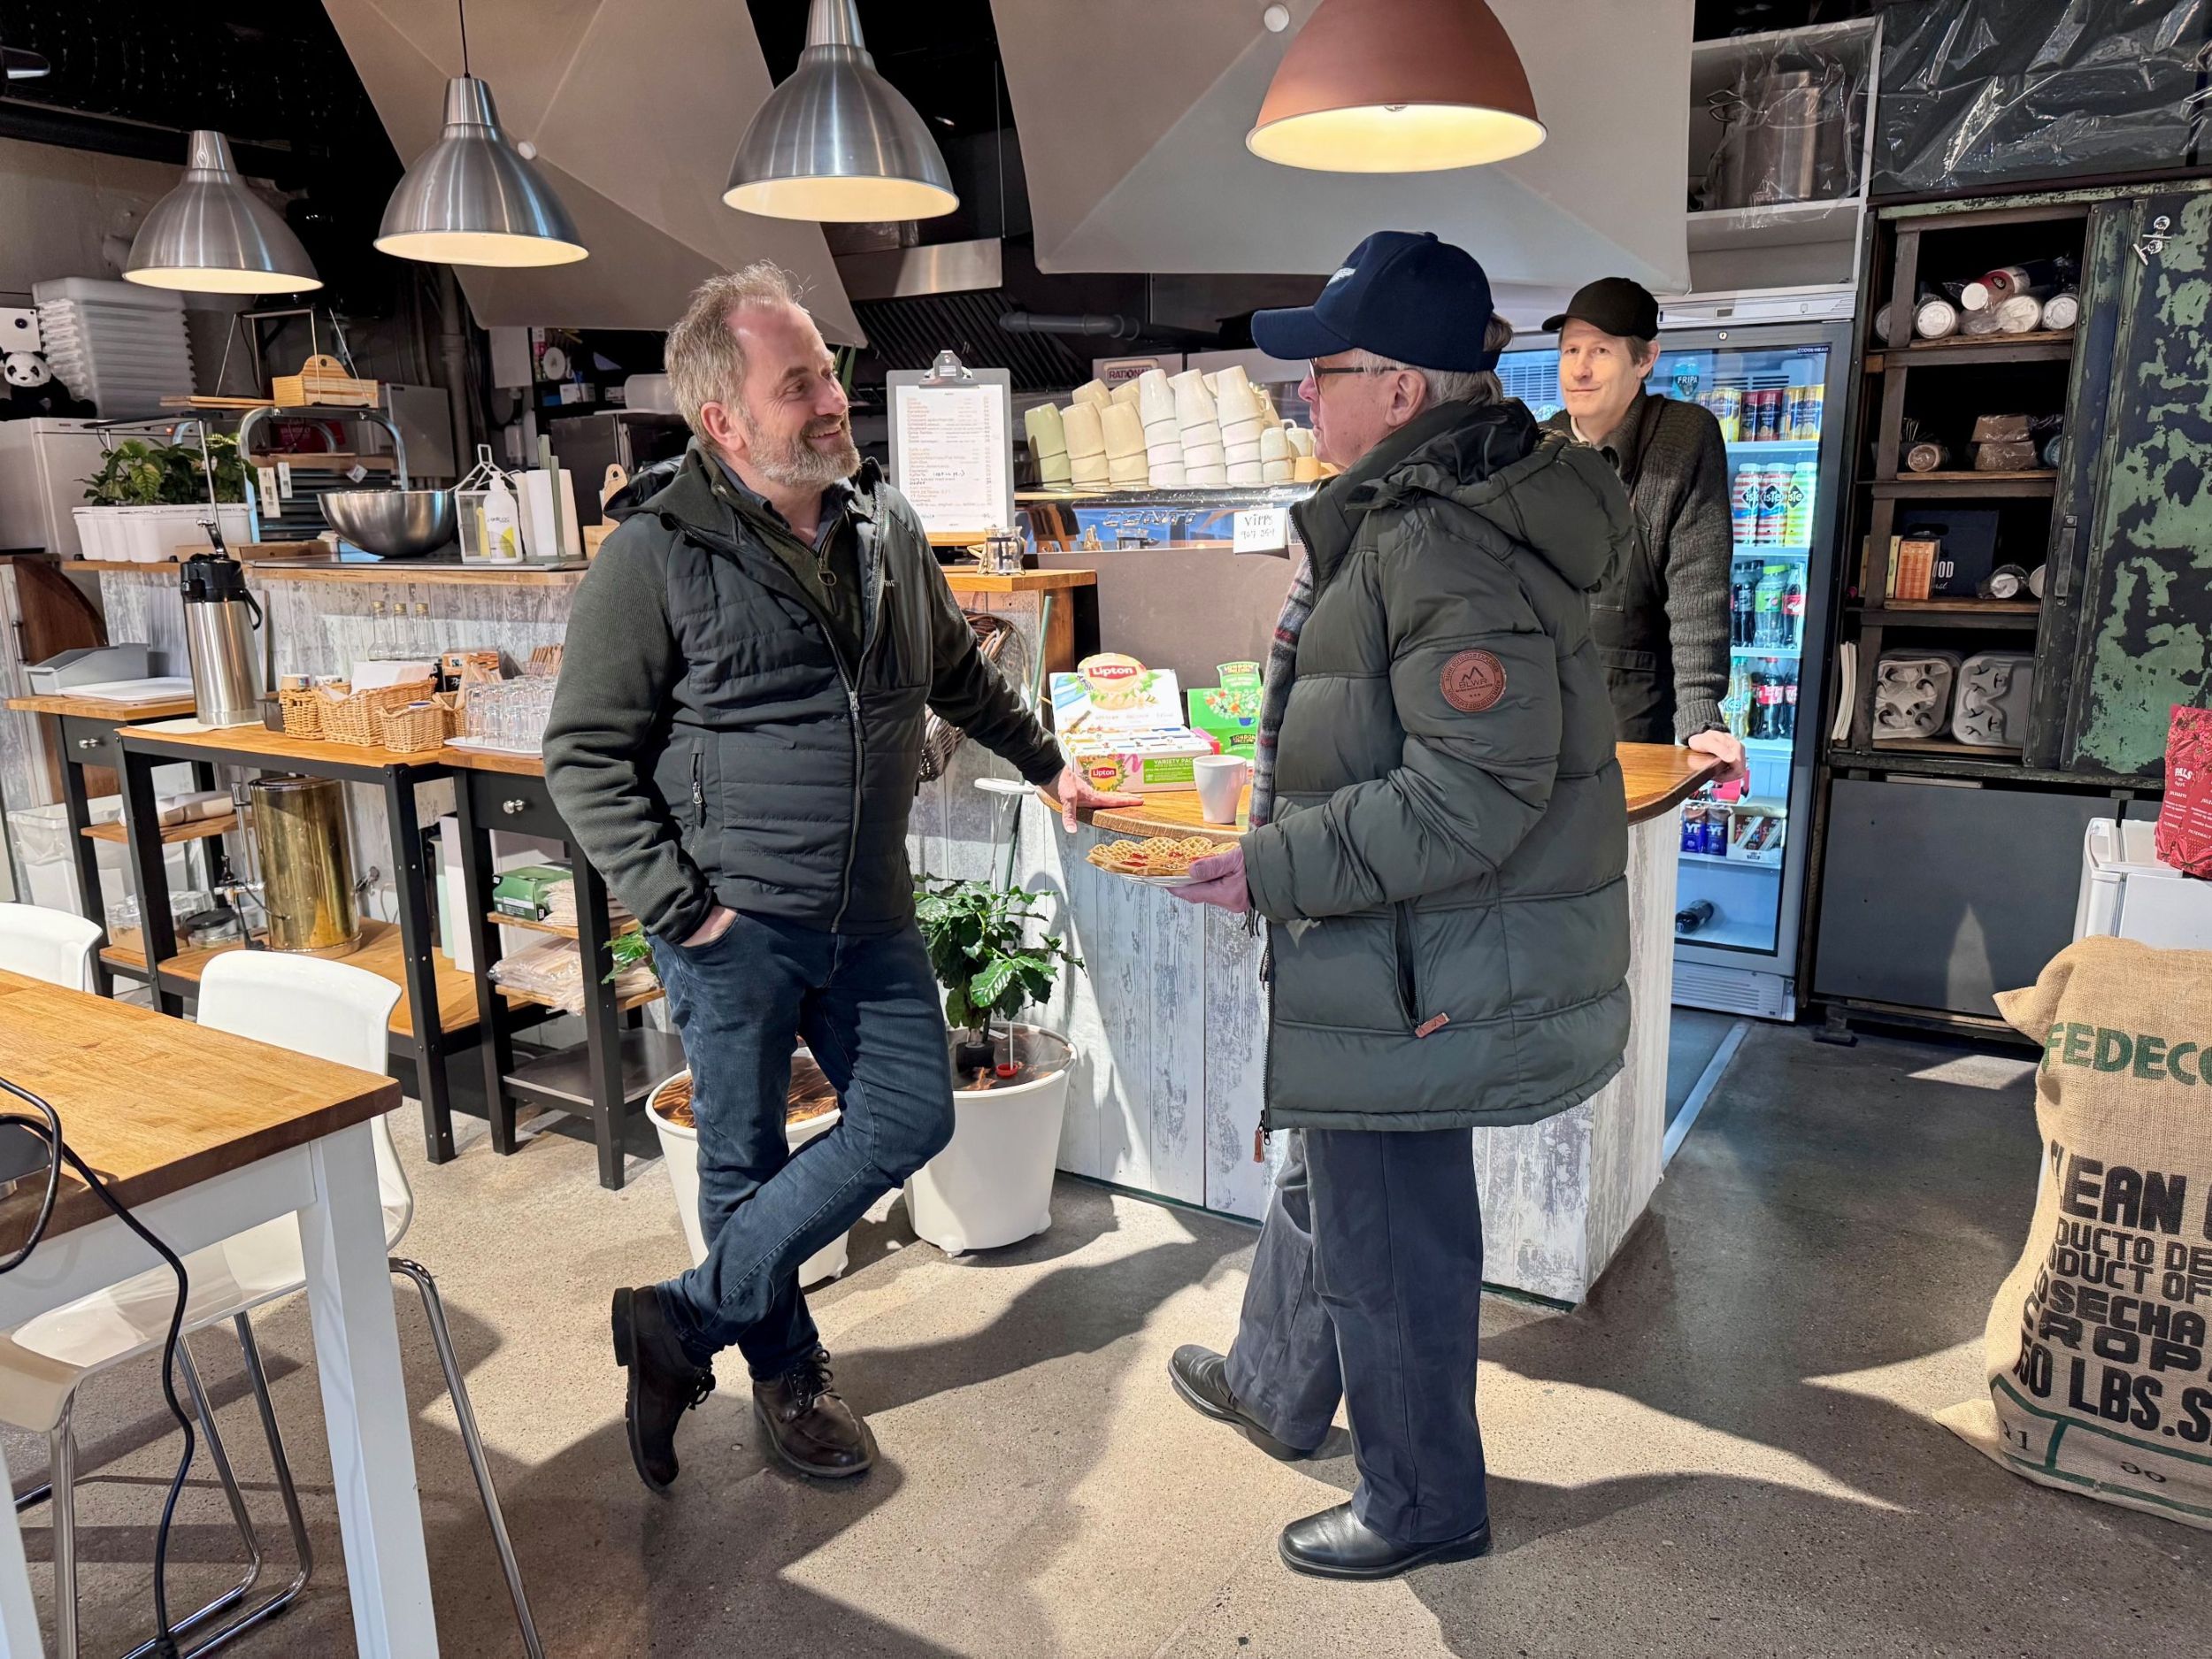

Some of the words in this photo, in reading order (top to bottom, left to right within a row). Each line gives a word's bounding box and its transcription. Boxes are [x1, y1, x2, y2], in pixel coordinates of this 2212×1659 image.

[1109, 367, 1150, 379] RATIONA
[1093, 665, 1133, 677] Lipton
[1093, 769, 1115, 778] Lipton
